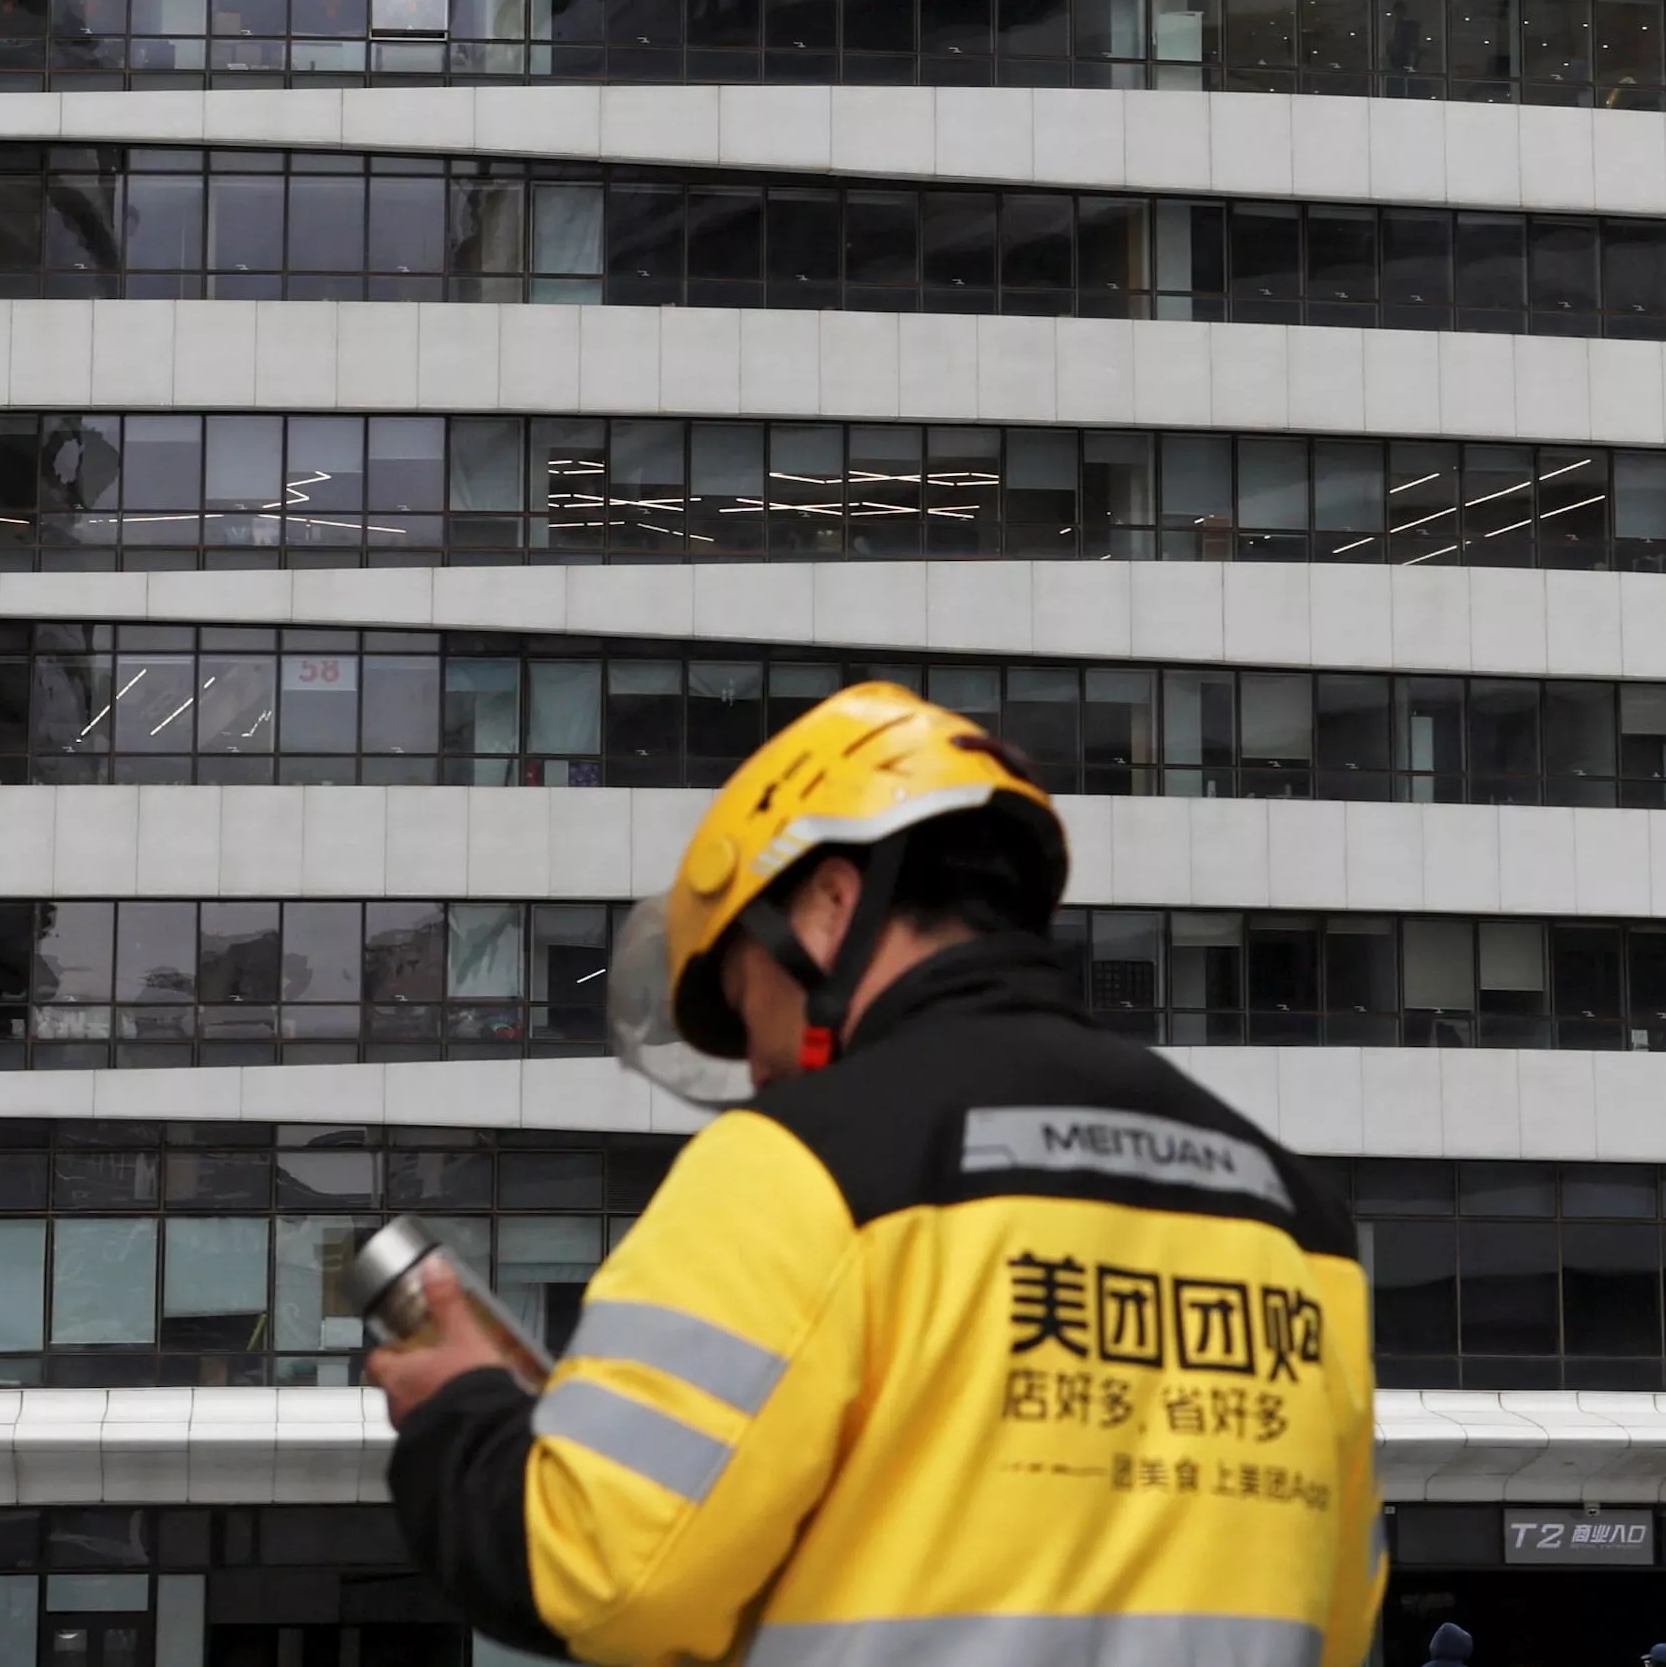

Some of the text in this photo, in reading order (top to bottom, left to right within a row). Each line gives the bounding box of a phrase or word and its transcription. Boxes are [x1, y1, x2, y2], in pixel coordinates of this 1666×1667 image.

[1042, 1122, 1235, 1173] MEITUAN
[1007, 1250, 1324, 1385] 美团团购
[1572, 1524, 1647, 1544] 商业入口
